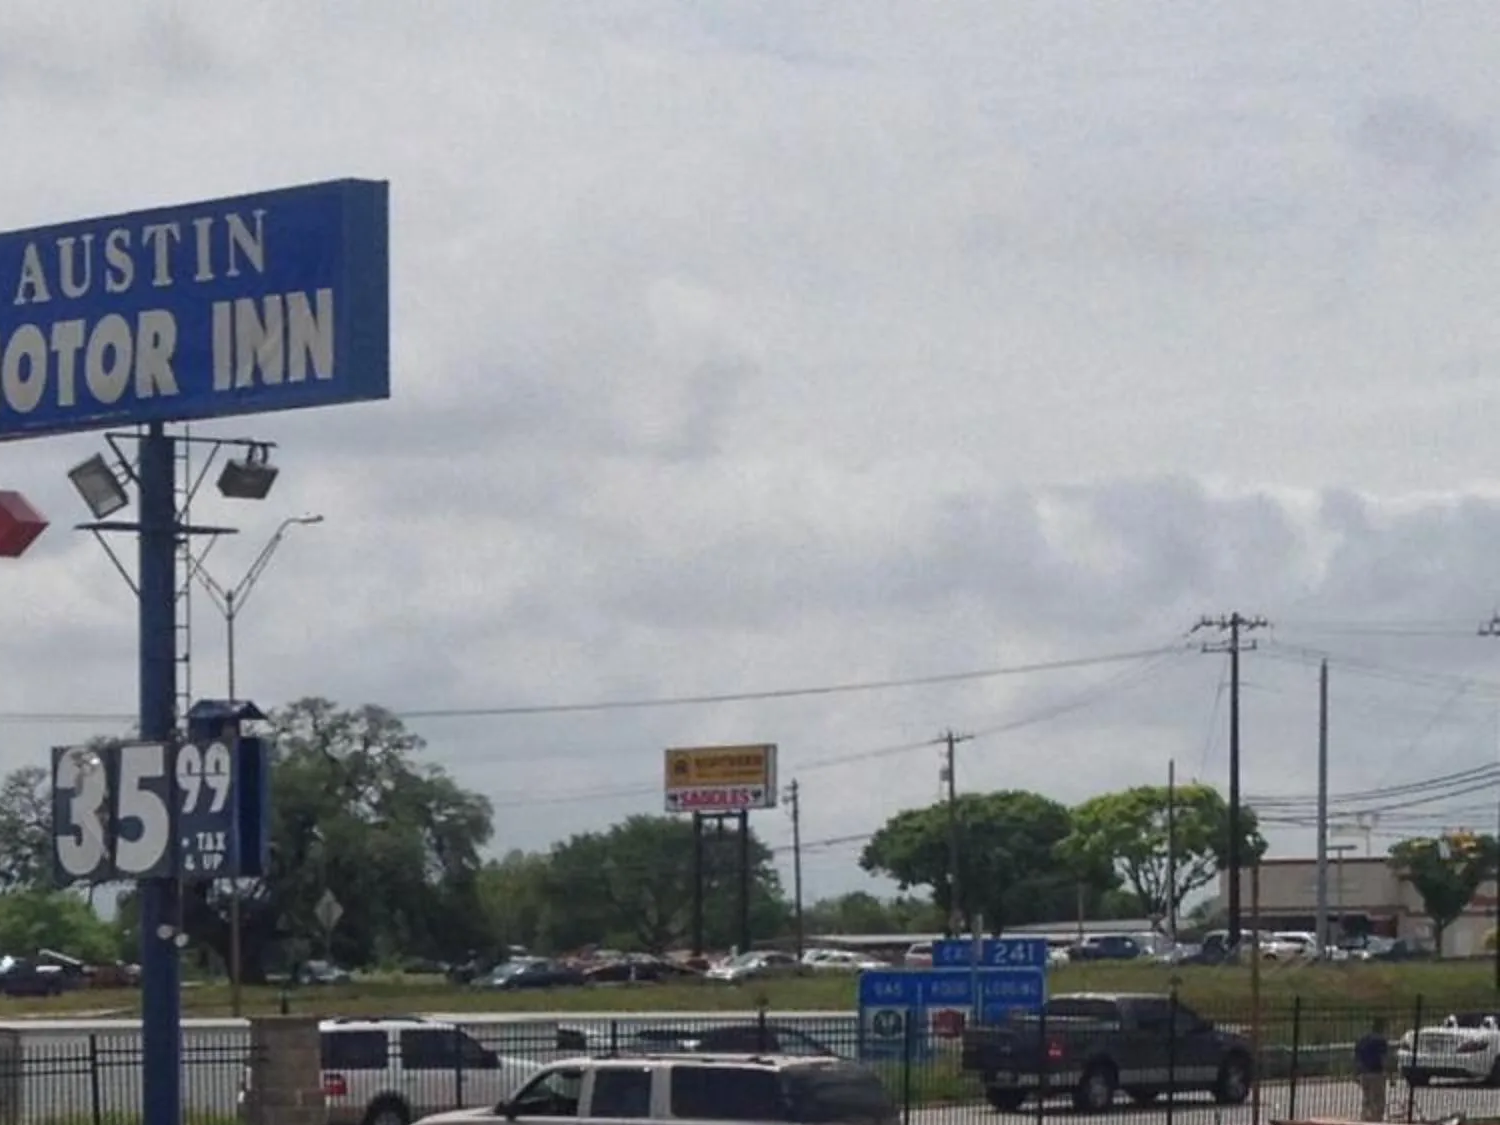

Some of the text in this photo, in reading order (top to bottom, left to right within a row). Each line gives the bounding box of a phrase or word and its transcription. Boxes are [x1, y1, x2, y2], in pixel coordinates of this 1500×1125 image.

[13, 209, 268, 306] AUSTIN
[213, 287, 334, 391] INN
[56, 742, 231, 876] 35 99
[196, 832, 227, 852] TAX
[202, 853, 224, 871] UP
[992, 943, 1035, 964] 241
